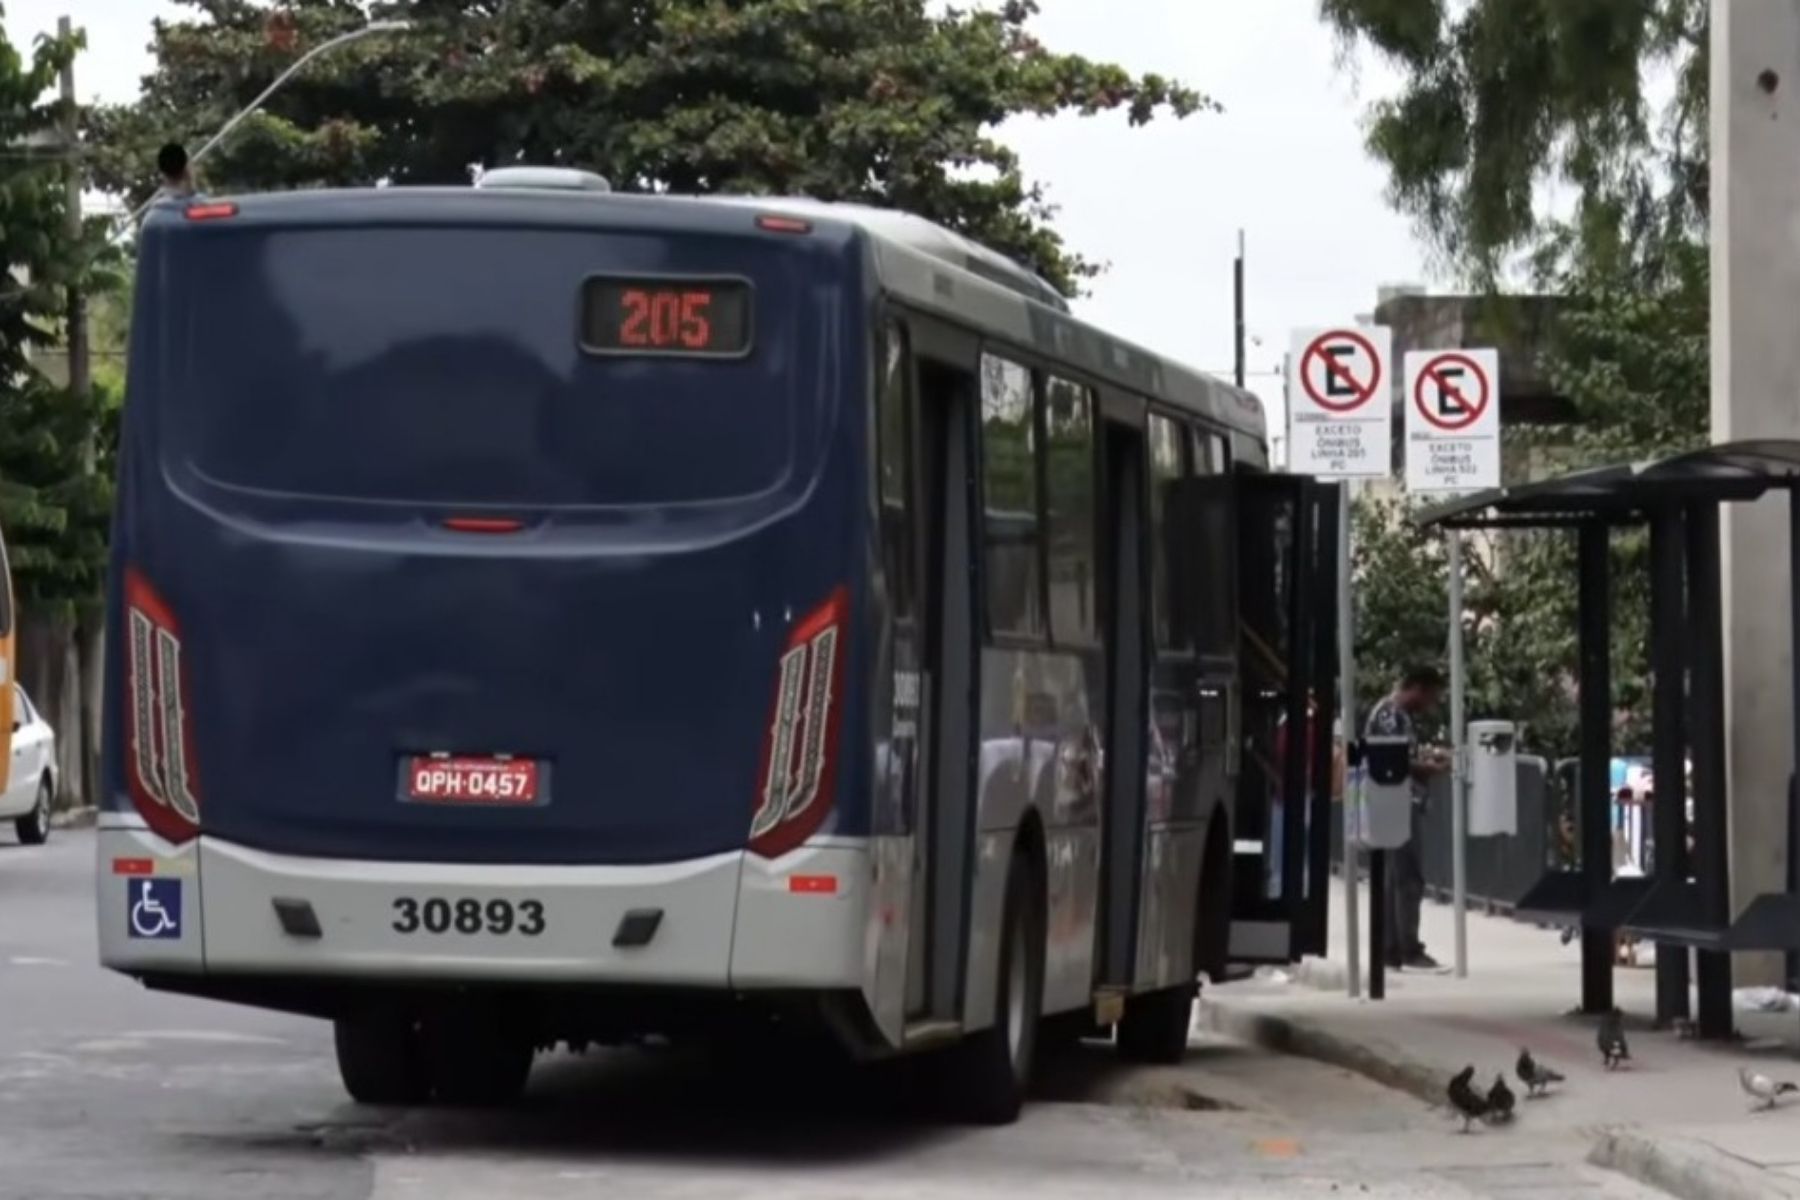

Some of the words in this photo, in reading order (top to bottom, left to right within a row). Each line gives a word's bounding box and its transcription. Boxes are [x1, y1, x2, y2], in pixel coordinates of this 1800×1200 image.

[619, 290, 711, 347] 205
[1314, 425, 1362, 435] EXCETO
[1428, 443, 1472, 452] EXCETO
[1311, 449, 1345, 459] LINHA
[1425, 464, 1457, 475] LINHA
[392, 897, 546, 936] 30893
